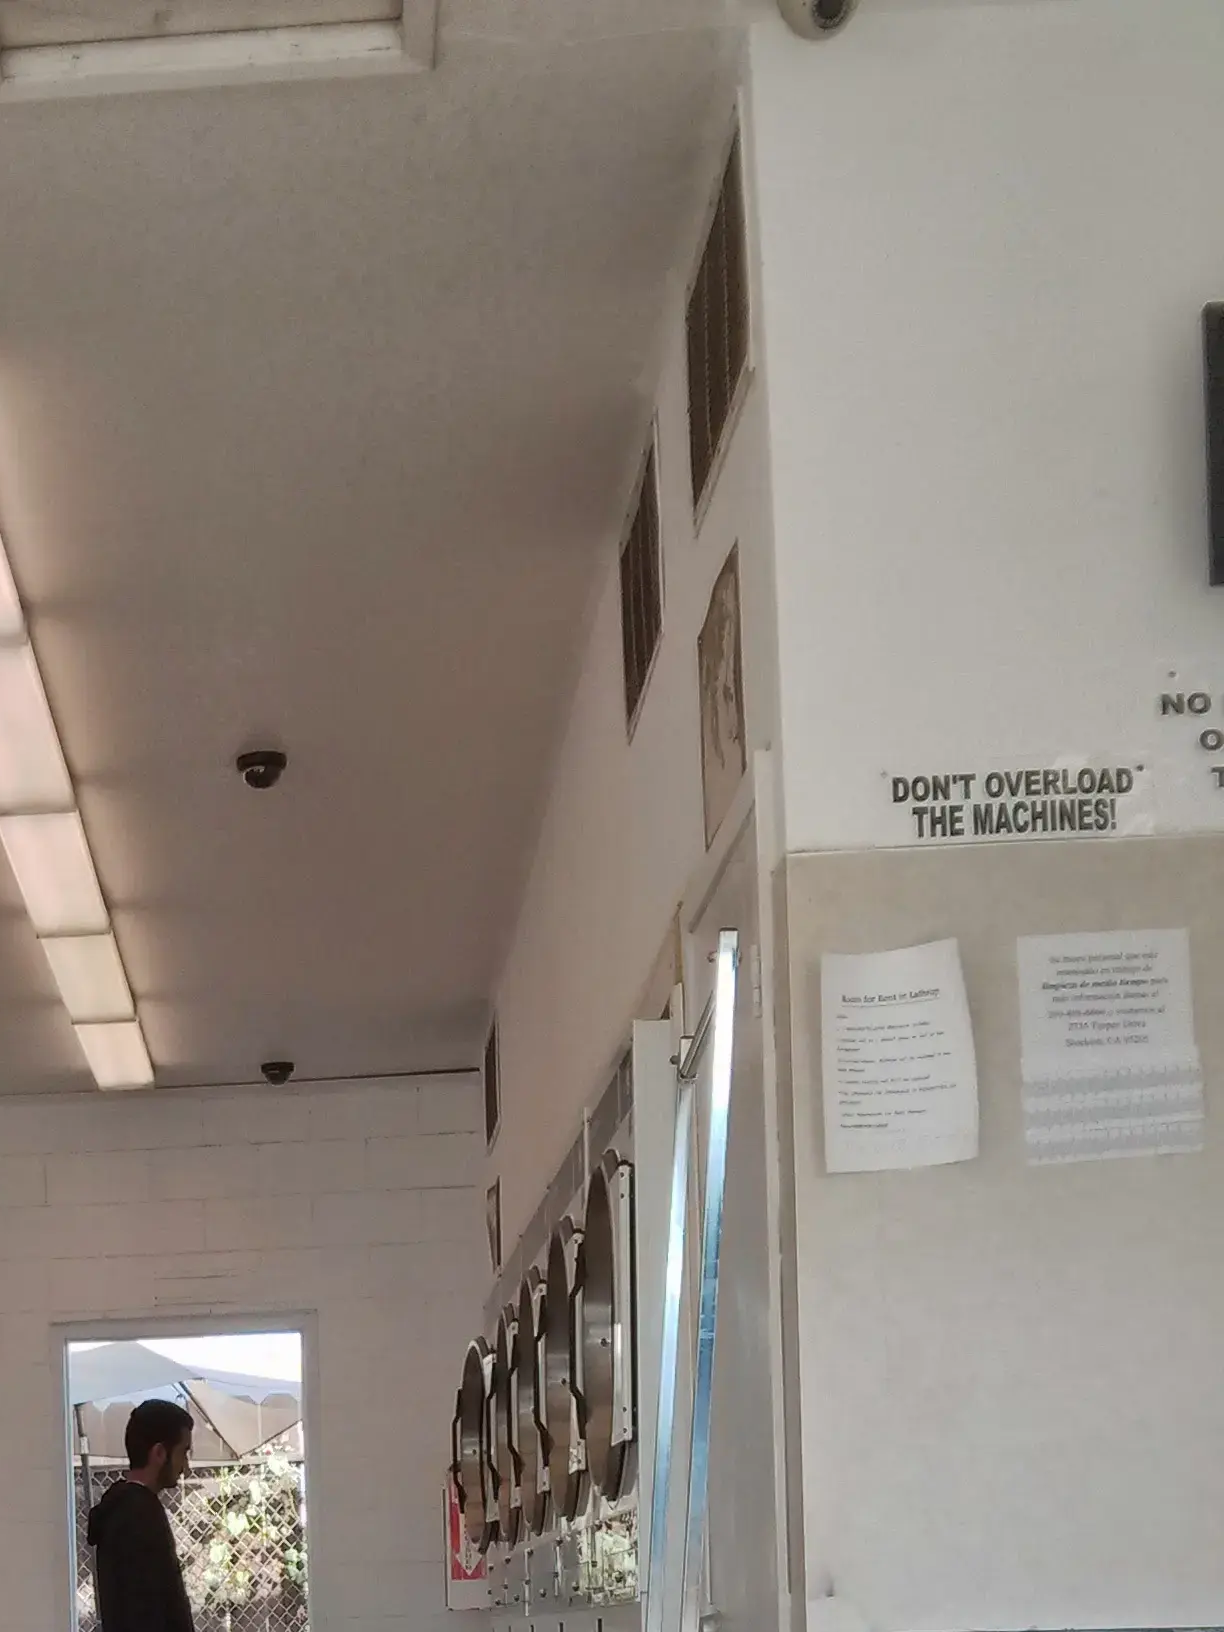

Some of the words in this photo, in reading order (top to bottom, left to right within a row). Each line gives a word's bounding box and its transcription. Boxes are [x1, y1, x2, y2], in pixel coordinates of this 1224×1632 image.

[1161, 692, 1211, 715] NO
[892, 773, 976, 803] DON'T
[984, 767, 1134, 798] OVERLOAD
[912, 804, 965, 838] THE
[973, 798, 1117, 836] MACHINES!
